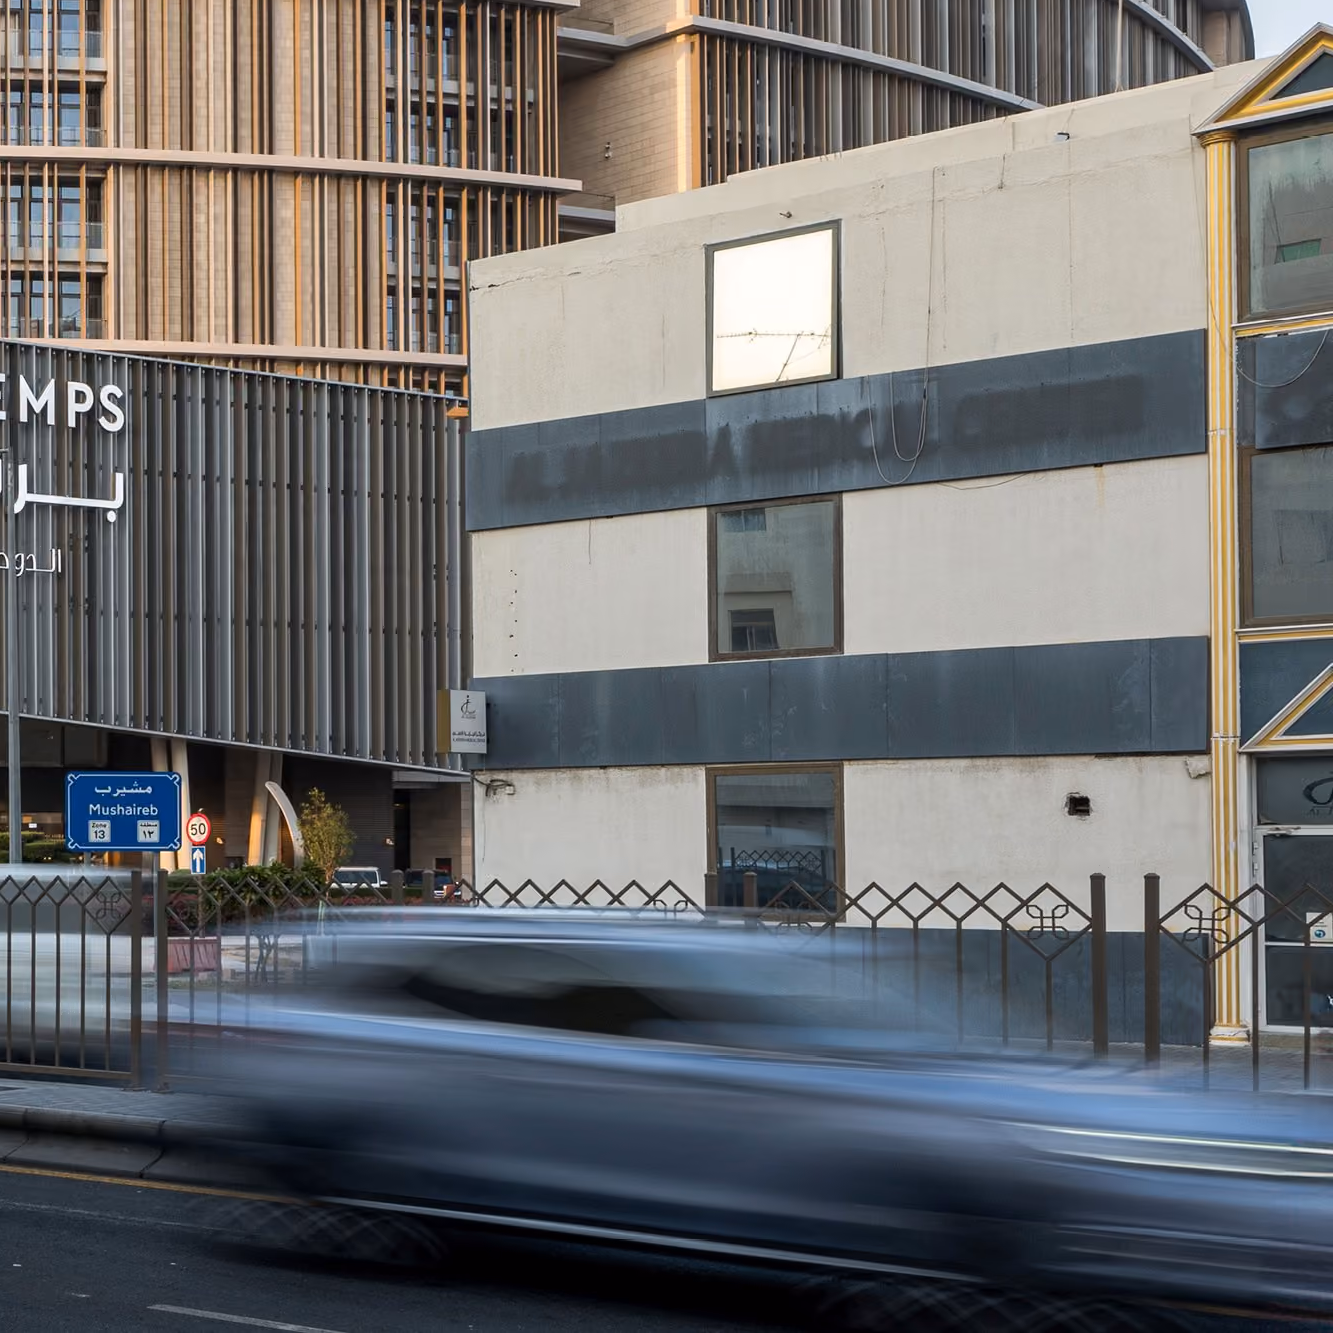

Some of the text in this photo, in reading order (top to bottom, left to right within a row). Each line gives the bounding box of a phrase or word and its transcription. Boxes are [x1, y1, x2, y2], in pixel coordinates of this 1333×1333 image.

[94, 781, 153, 797] مشيرب
[89, 803, 159, 816] Mushaireb
[94, 830, 106, 839] 13
[190, 823, 206, 836] 50
